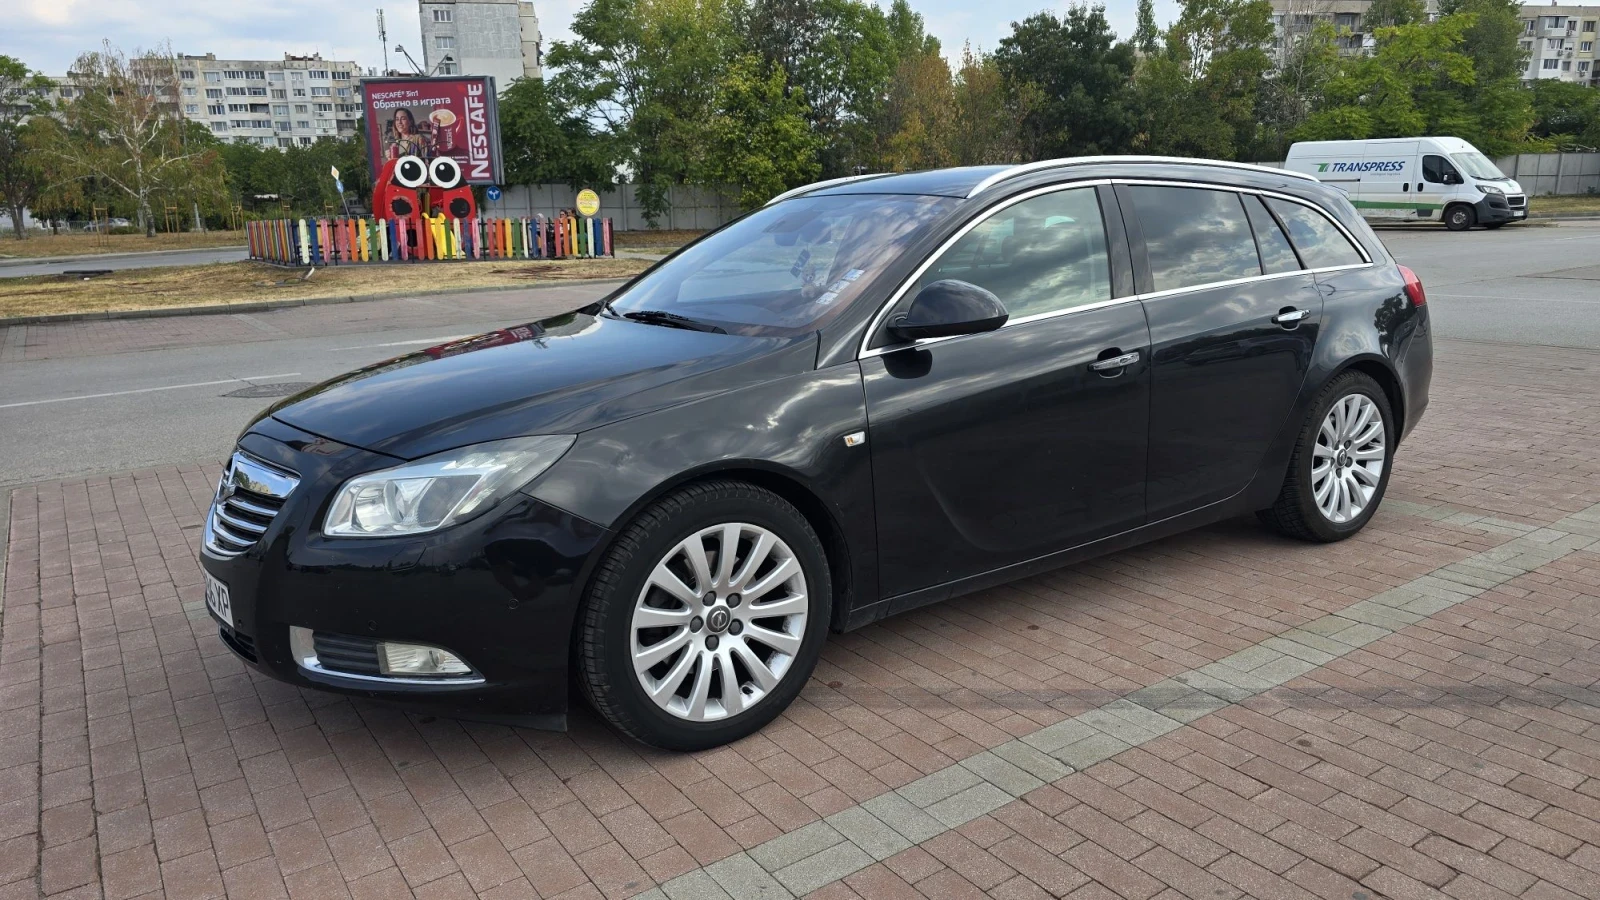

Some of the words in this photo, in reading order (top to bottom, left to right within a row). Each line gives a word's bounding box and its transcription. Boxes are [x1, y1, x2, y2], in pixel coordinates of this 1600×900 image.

[373, 99, 411, 110] Обратно
[420, 97, 451, 108] играта
[1332, 161, 1405, 172] TRANSPRESS
